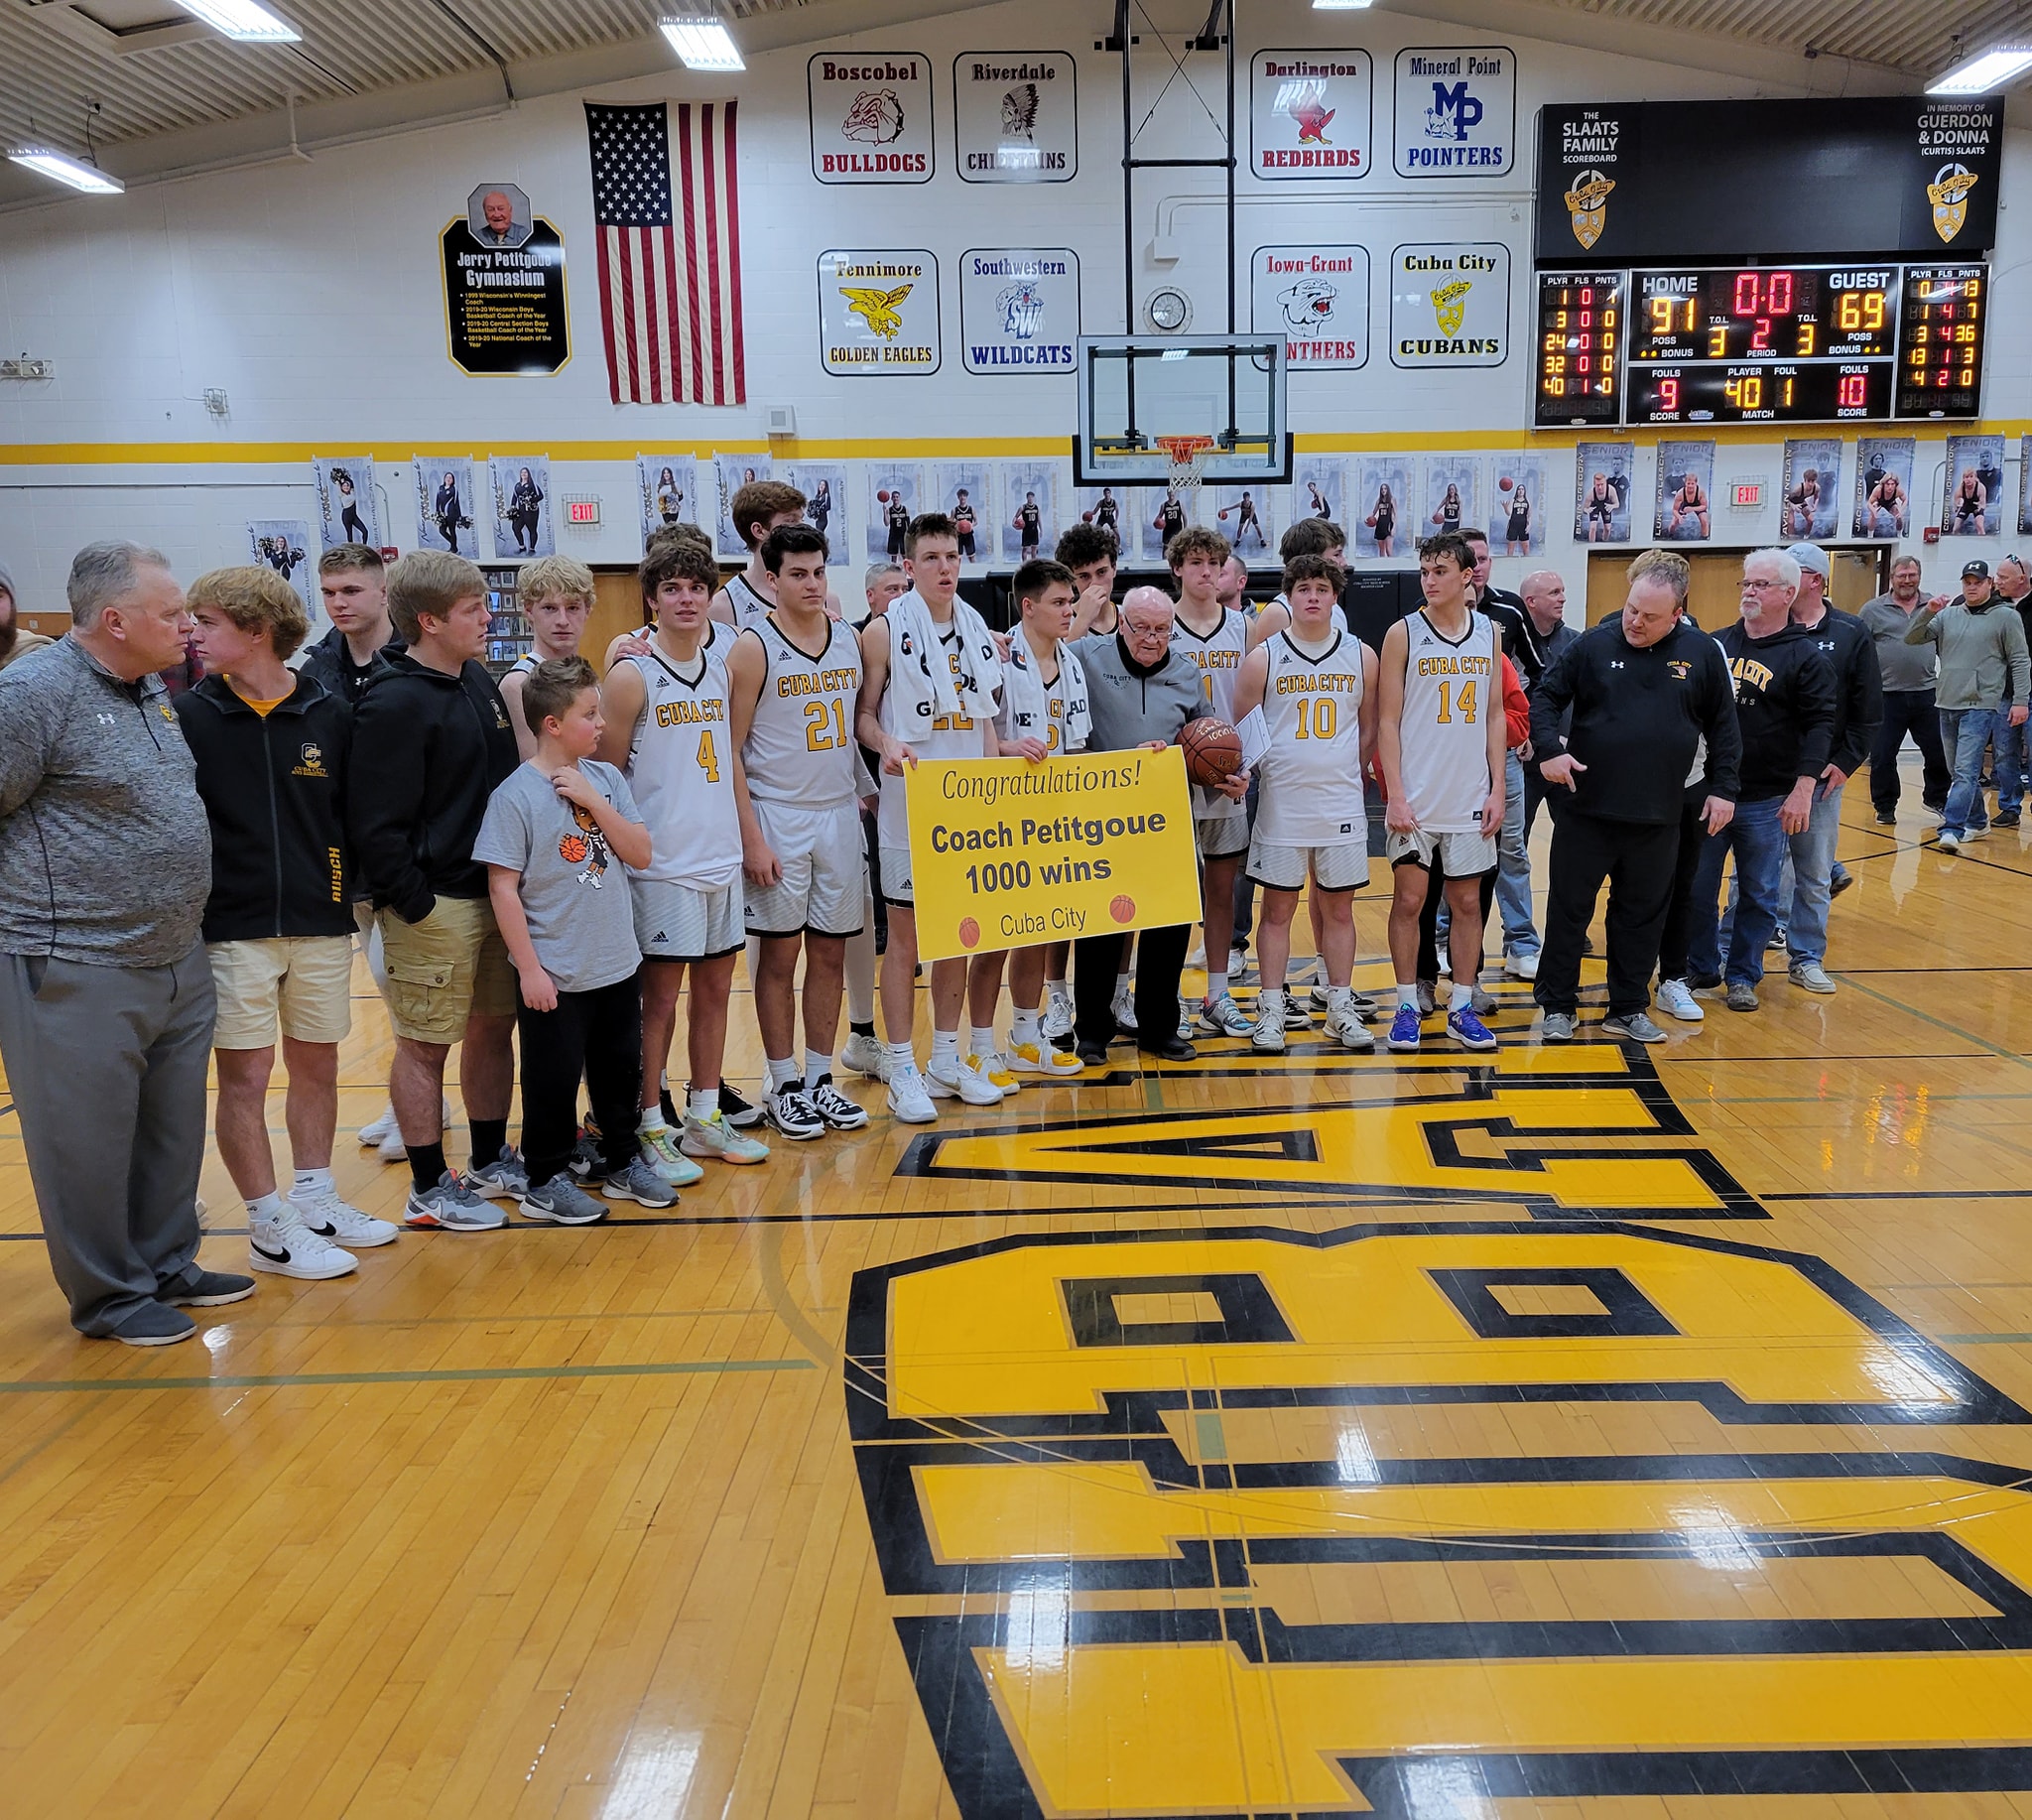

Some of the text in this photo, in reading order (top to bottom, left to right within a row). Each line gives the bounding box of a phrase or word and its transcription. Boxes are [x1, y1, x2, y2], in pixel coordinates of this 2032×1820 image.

[823, 63, 917, 80] Boscobel
[972, 64, 1056, 80] Riverdale
[1265, 62, 1356, 77] Darlington
[1410, 56, 1501, 76] Mineral Point
[1432, 81, 1483, 141] MP
[1974, 103, 1985, 112] OF
[1563, 121, 1619, 137] SLAATS
[1917, 114, 1993, 128] GUERDON
[1563, 137, 1618, 153] FAMILY
[1918, 130, 1989, 144] & DONNA
[1262, 150, 1360, 168] REDBIRDS
[1408, 147, 1502, 167] POINTERS
[1563, 154, 1618, 164] SCOREBOARD
[1921, 147, 1955, 156] (CURTIS)
[823, 155, 926, 173] BULLDOGS
[457, 252, 552, 269] Jerry Petitgoue
[837, 261, 922, 277] Fennimore
[973, 258, 1067, 276] Southwestern
[1266, 255, 1353, 273] Iowa-Grant
[1405, 254, 1497, 272] Cuba City
[466, 269, 545, 288] Gymnasium
[1643, 277, 1698, 293] HOME
[1829, 273, 1889, 289] GUEST
[1582, 289, 1591, 304] 0
[1920, 281, 1930, 298] 0
[1557, 311, 1615, 327] 3 0 0
[1652, 298, 1695, 332] 91
[1841, 293, 1883, 329] 69
[1943, 303, 1977, 319] 4 7
[1546, 332, 1614, 350] 24 0 0
[1709, 326, 1725, 356] 3
[1752, 319, 1770, 349] 2
[1797, 325, 1815, 355] 3
[1847, 332, 1872, 341] POSS
[1917, 325, 1975, 341] 3 4 36
[830, 347, 932, 362] GOLDEN EAGLES
[971, 345, 1072, 364] WILDCATS
[1265, 341, 1355, 360] NTHERS
[1400, 339, 1499, 356] CUBANS
[1829, 345, 1861, 354] BONUS
[1911, 347, 1973, 364] 13 3
[1546, 355, 1613, 373] 32 0 0
[1840, 365, 1869, 374] FOULS
[1651, 369, 1681, 378] FOULS
[1914, 369, 1972, 386] 4 2 0
[1544, 377, 1612, 395] 40 0
[1661, 380, 1678, 410] 9
[1725, 378, 1761, 408] 40
[1840, 376, 1864, 406] 10
[1650, 412, 1680, 421] SCORE
[1742, 410, 1775, 419] MATCH
[1585, 446, 1629, 455] SENIOR
[1665, 444, 1710, 454] SENIOR
[1791, 443, 1837, 452] SENIOR
[1865, 442, 1909, 451] SENIOR
[1956, 439, 1998, 448] SENIOR
[1737, 486, 1759, 503] EXIT
[572, 503, 593, 521] EXIT
[1418, 656, 1491, 676] CUBA CITY
[778, 668, 858, 698] CUBA CITY
[1277, 674, 1356, 695] CUBA CITY
[1743, 659, 1774, 693] CITY
[1437, 681, 1476, 724] 14
[656, 699, 724, 728] CUBA CIT
[1295, 698, 1336, 739] 10
[804, 698, 848, 752] 21
[697, 730, 720, 783] 4
[942, 759, 1142, 805] Congratulations!
[932, 812, 1167, 853] Coach Petitgoue
[965, 856, 1112, 894] 1000 wins
[1000, 907, 1087, 937] Cuba City
